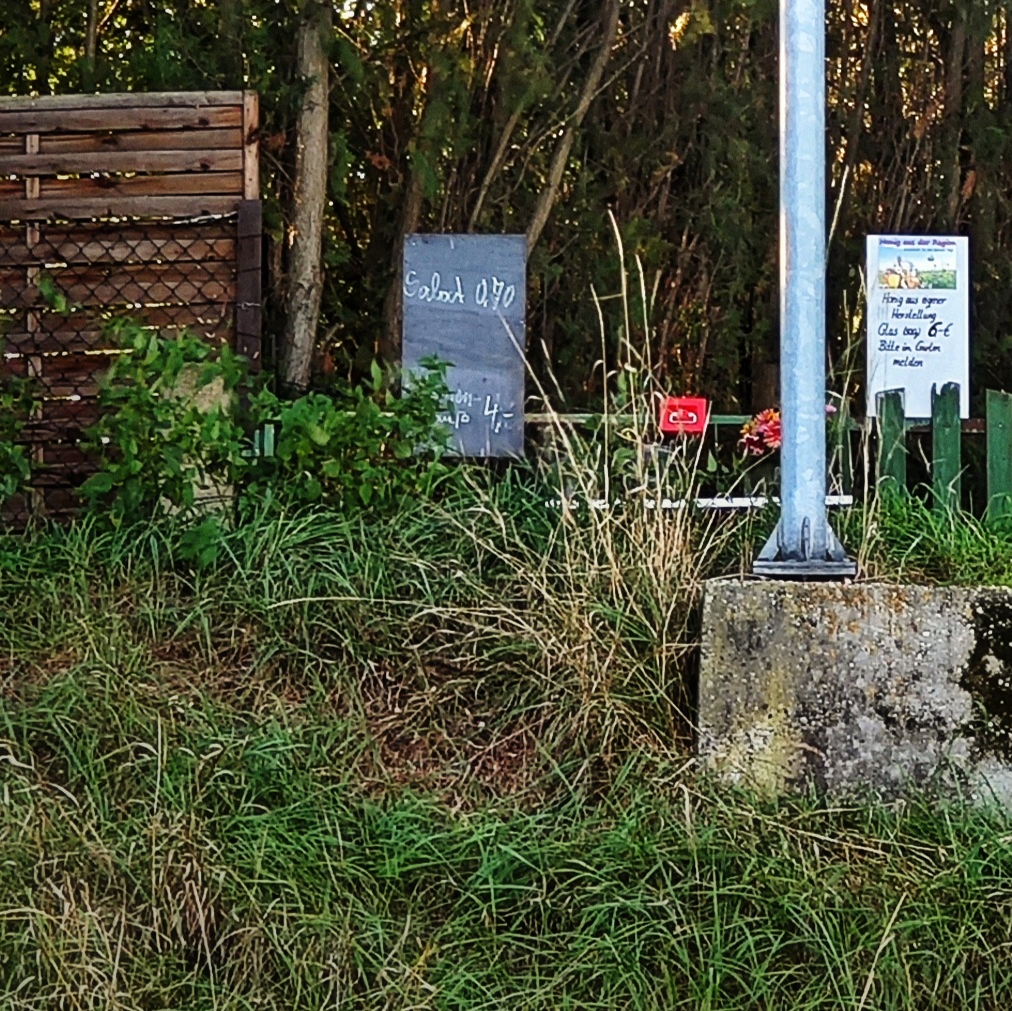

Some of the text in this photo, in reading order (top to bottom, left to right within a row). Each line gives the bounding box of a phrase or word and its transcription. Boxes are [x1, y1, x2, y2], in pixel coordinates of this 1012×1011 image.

[403, 270, 465, 304] Salat
[877, 339, 900, 352] Bitte
[892, 356, 924, 367] melden
